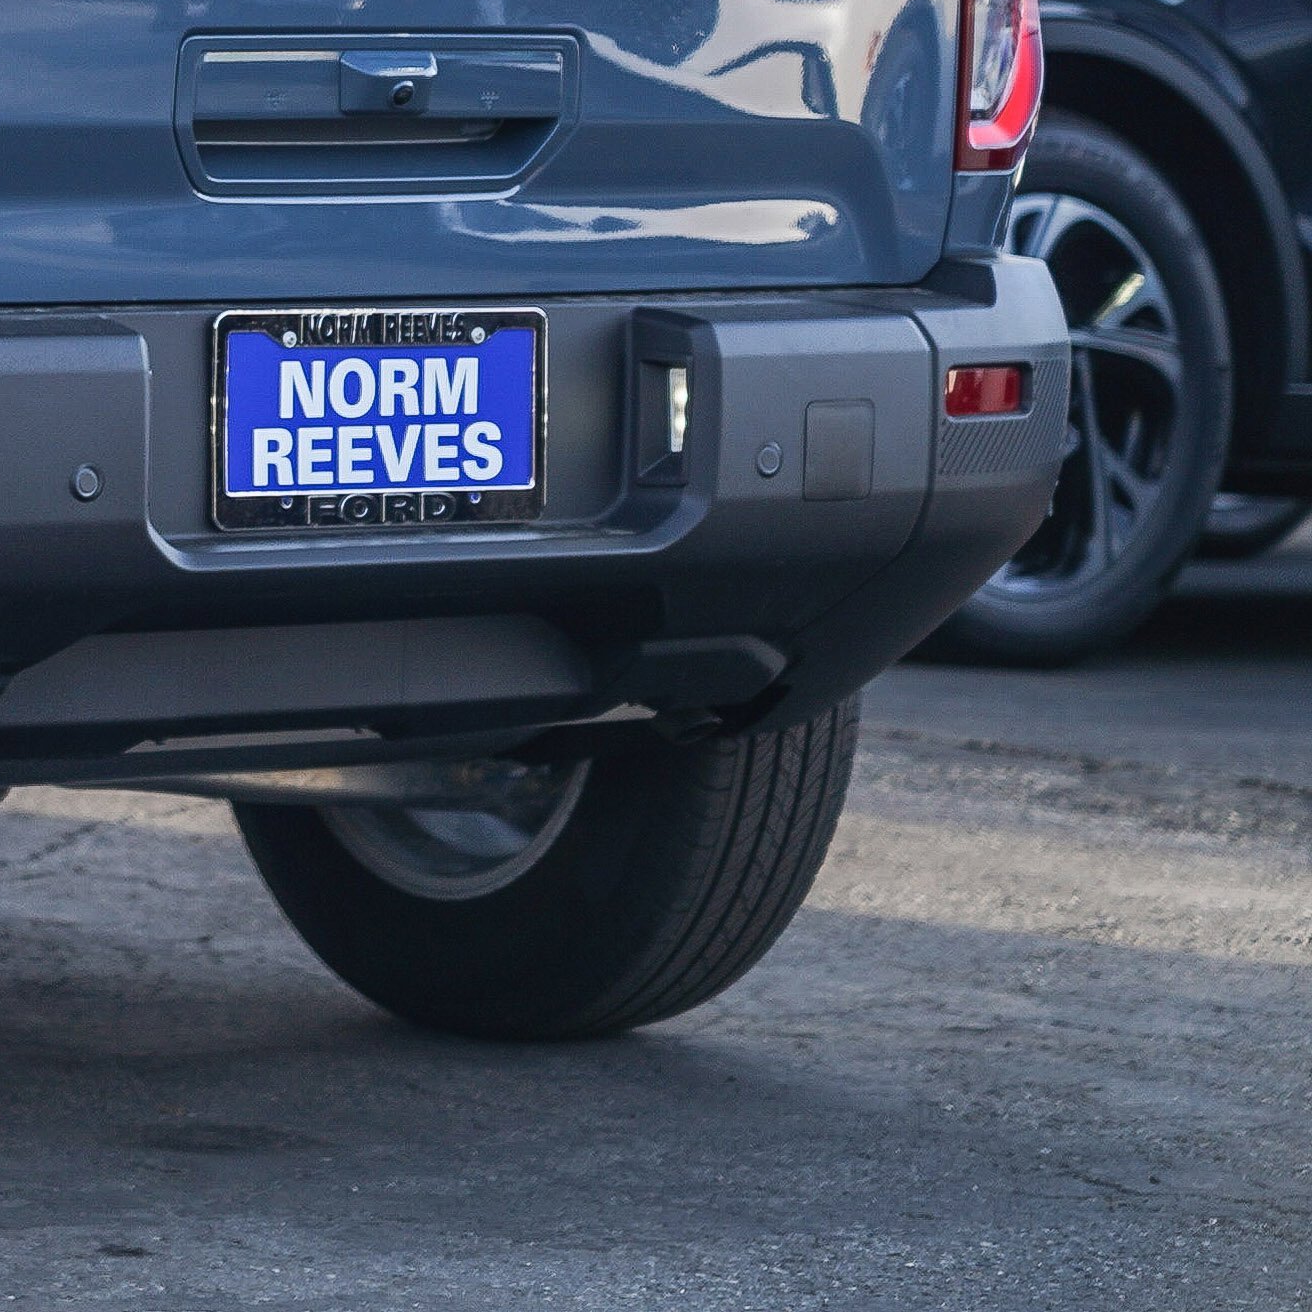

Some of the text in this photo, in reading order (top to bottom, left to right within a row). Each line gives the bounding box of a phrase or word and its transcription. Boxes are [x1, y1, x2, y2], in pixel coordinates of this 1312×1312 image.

[279, 356, 479, 420] NORM
[252, 420, 504, 487] REEVES
[306, 492, 457, 525] FORD
